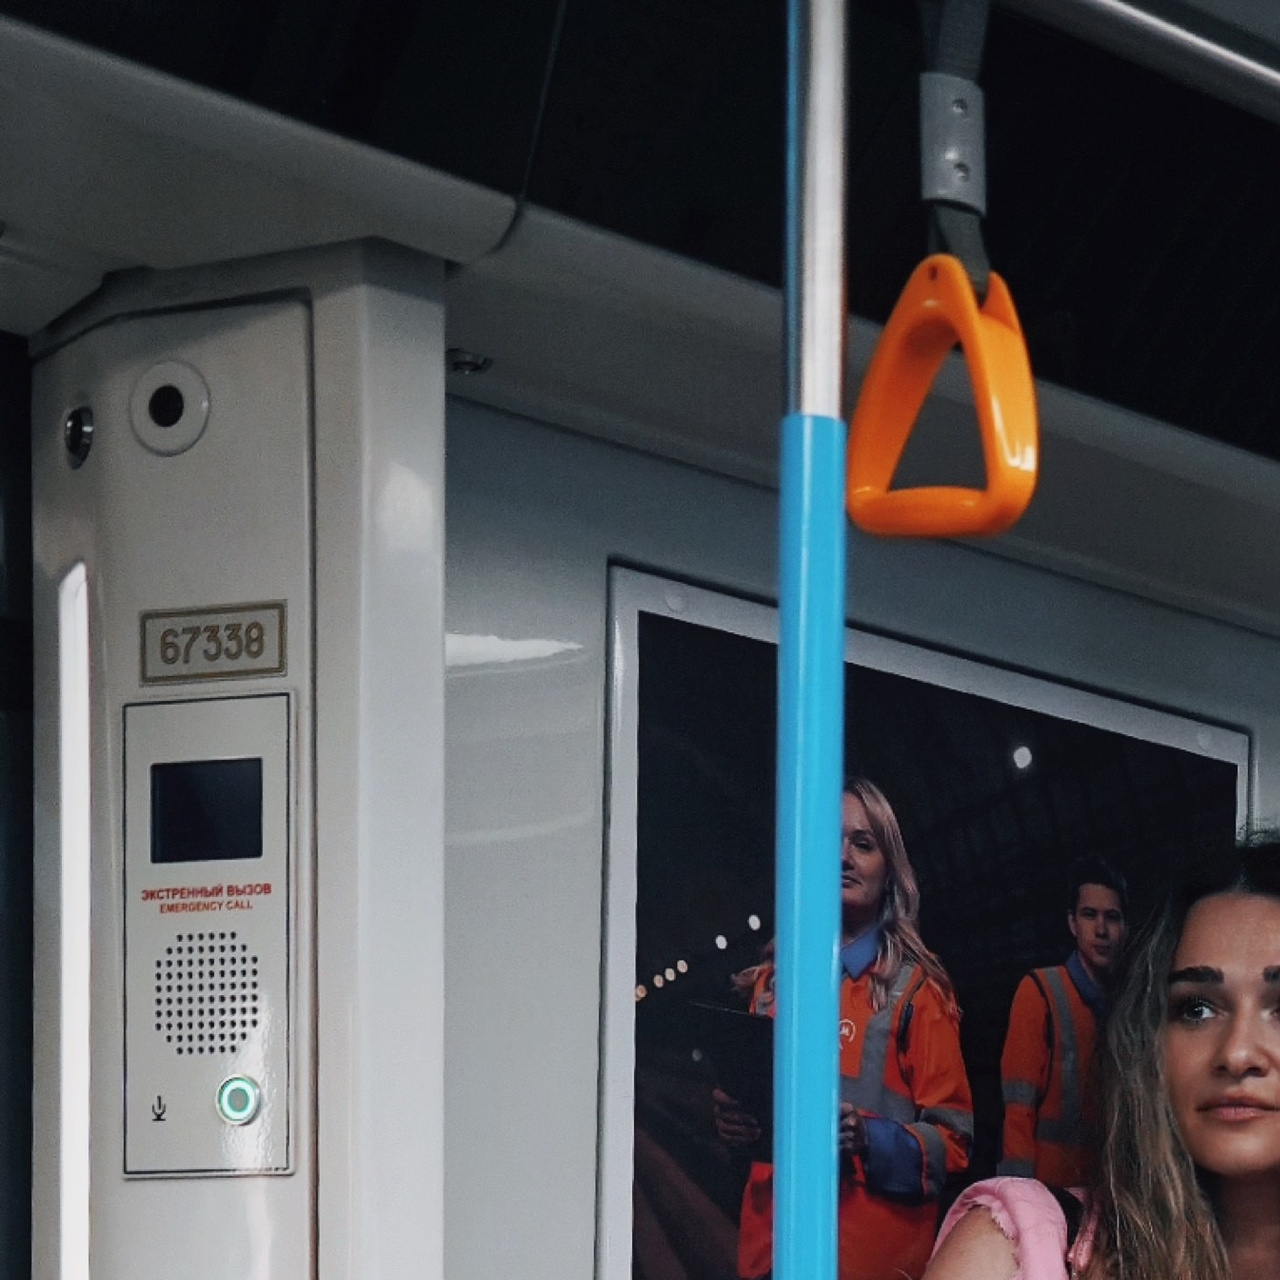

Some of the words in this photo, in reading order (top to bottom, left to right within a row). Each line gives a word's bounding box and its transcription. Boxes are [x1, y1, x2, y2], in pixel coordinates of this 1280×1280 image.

[160, 621, 265, 665] 67338
[141, 884, 224, 901] ЭКСТРЕННЫЙ
[227, 883, 272, 898] ВЫЗОВ
[160, 901, 223, 914] EMERGENCY
[226, 900, 253, 911] CALL
